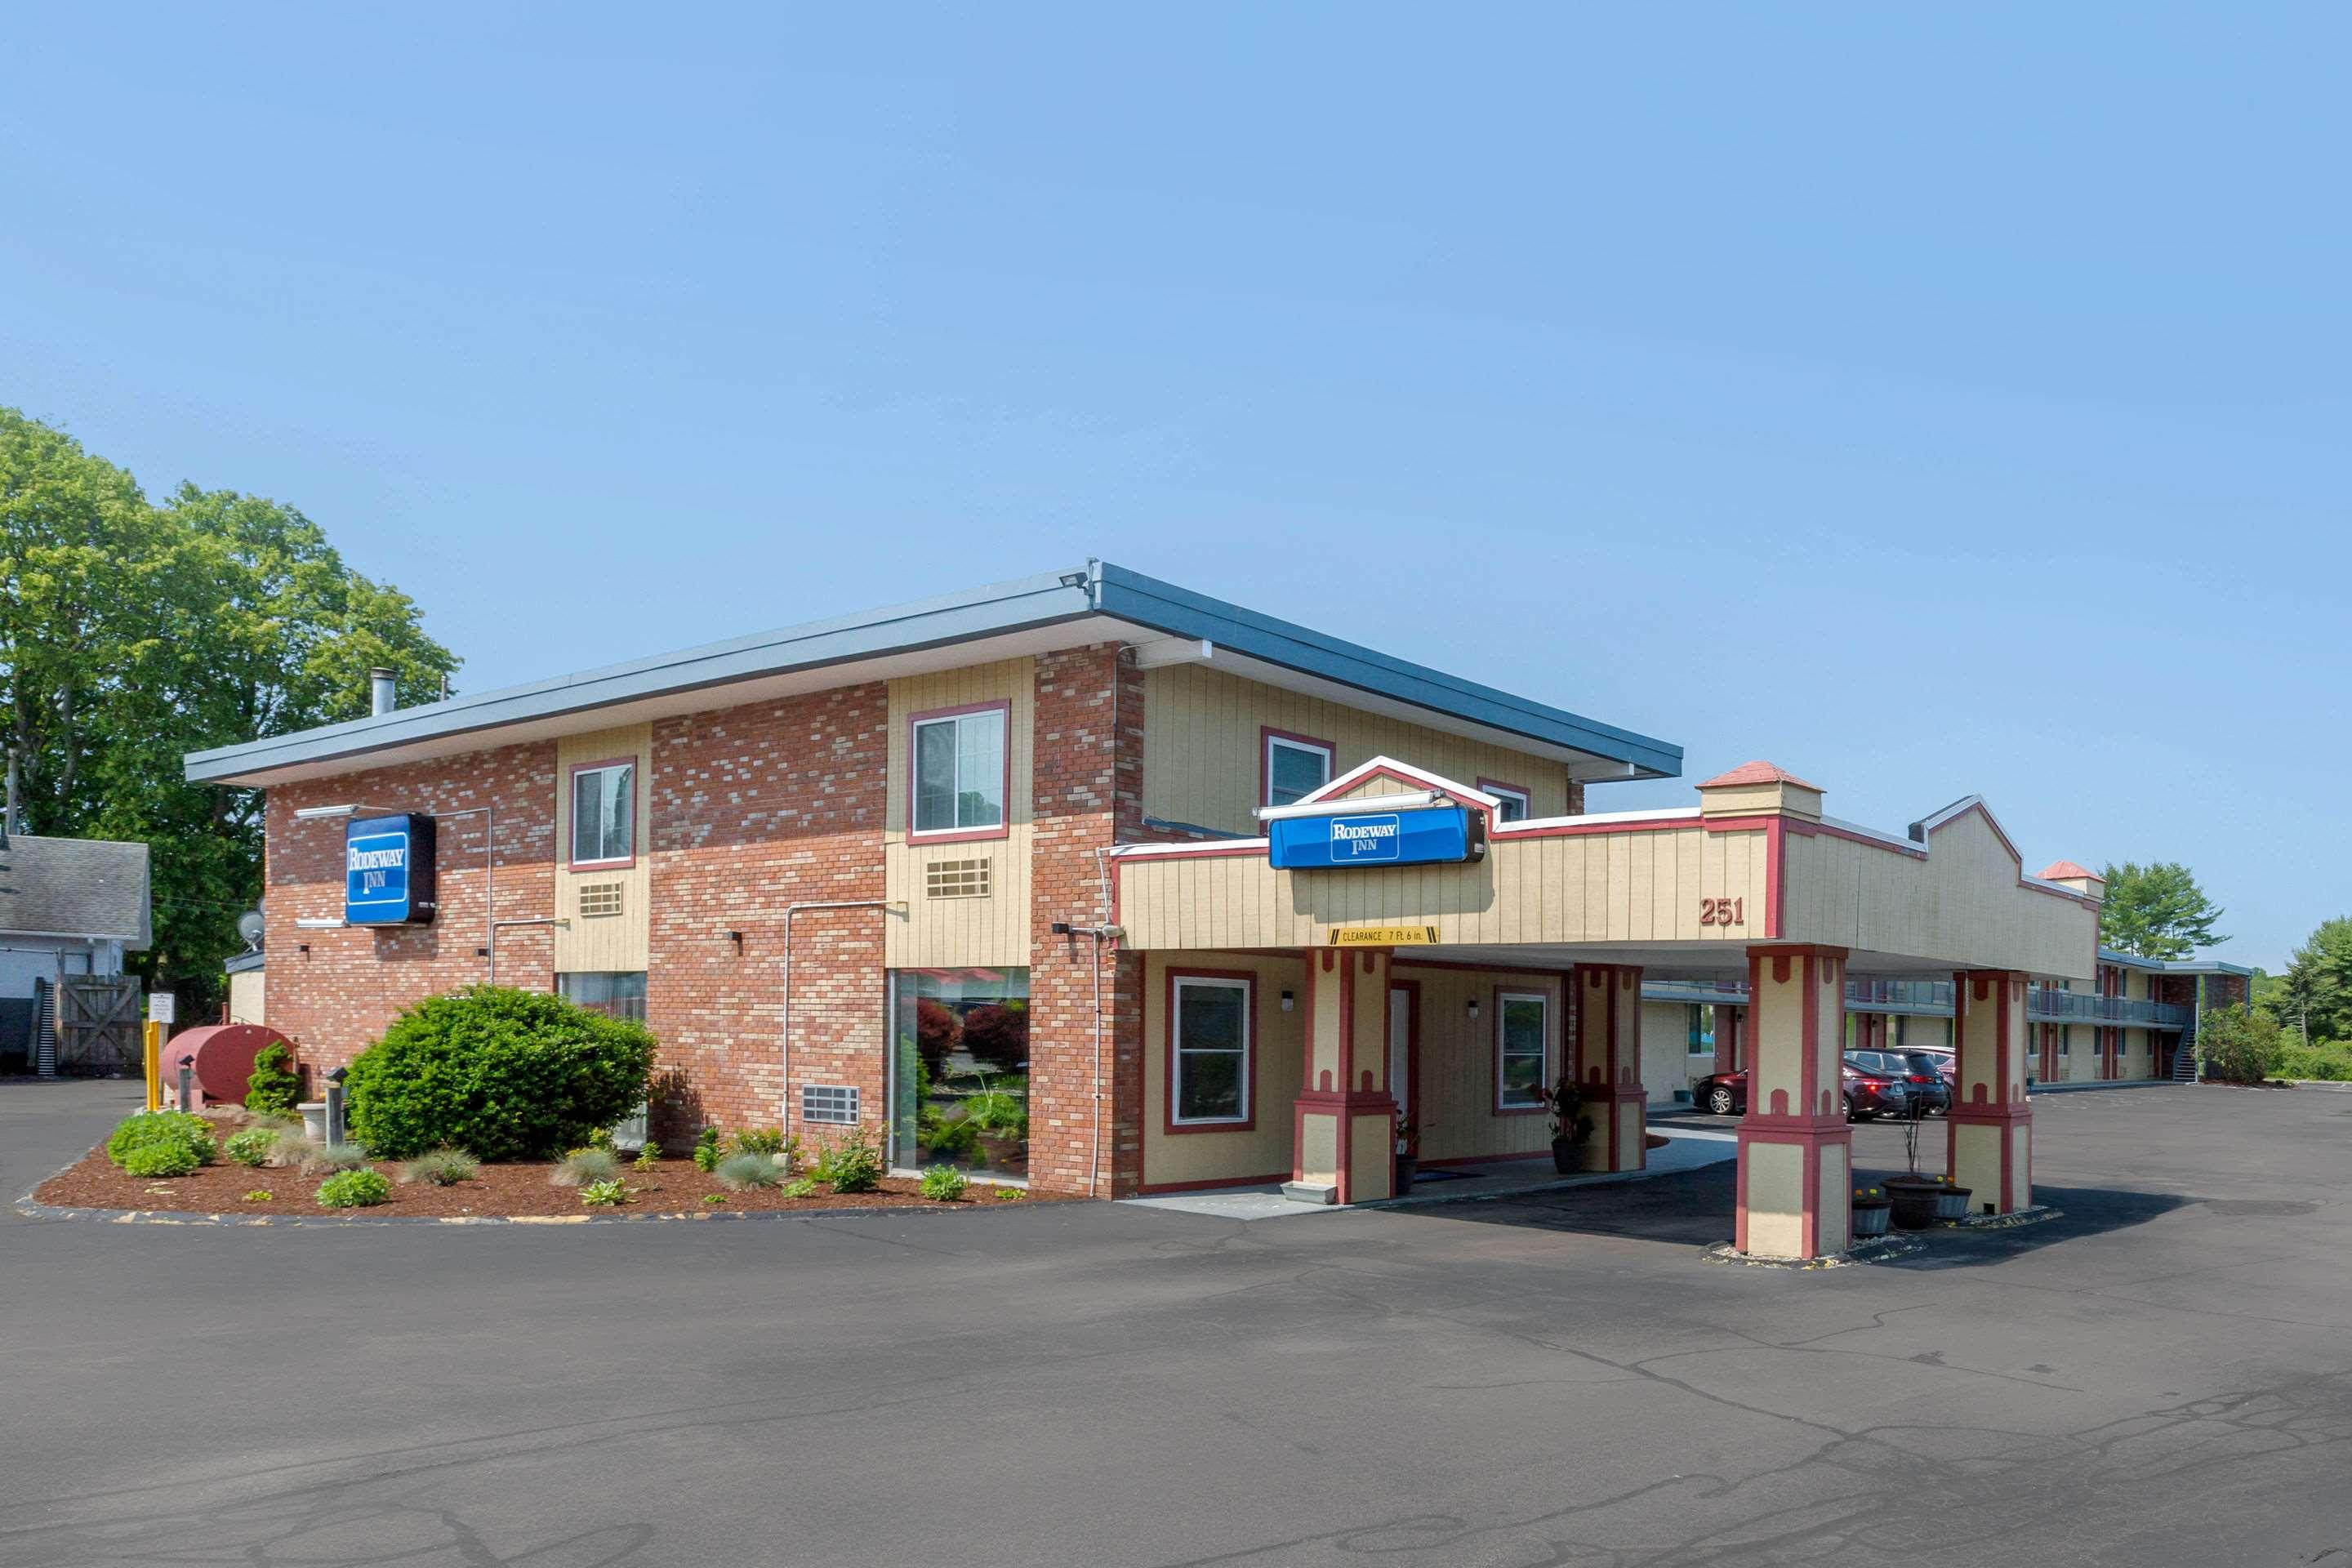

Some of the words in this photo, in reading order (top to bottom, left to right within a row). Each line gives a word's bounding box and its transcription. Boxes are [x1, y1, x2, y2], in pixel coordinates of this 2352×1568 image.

[1333, 824, 1396, 840] RODEWAY
[1352, 839, 1377, 855] INN
[349, 848, 404, 871] RODEWAY
[363, 871, 385, 894] INN
[1699, 897, 1744, 926] 251
[1343, 931, 1382, 942] CLEARANCE
[1388, 931, 1394, 940] 7
[1406, 931, 1412, 940] 6
